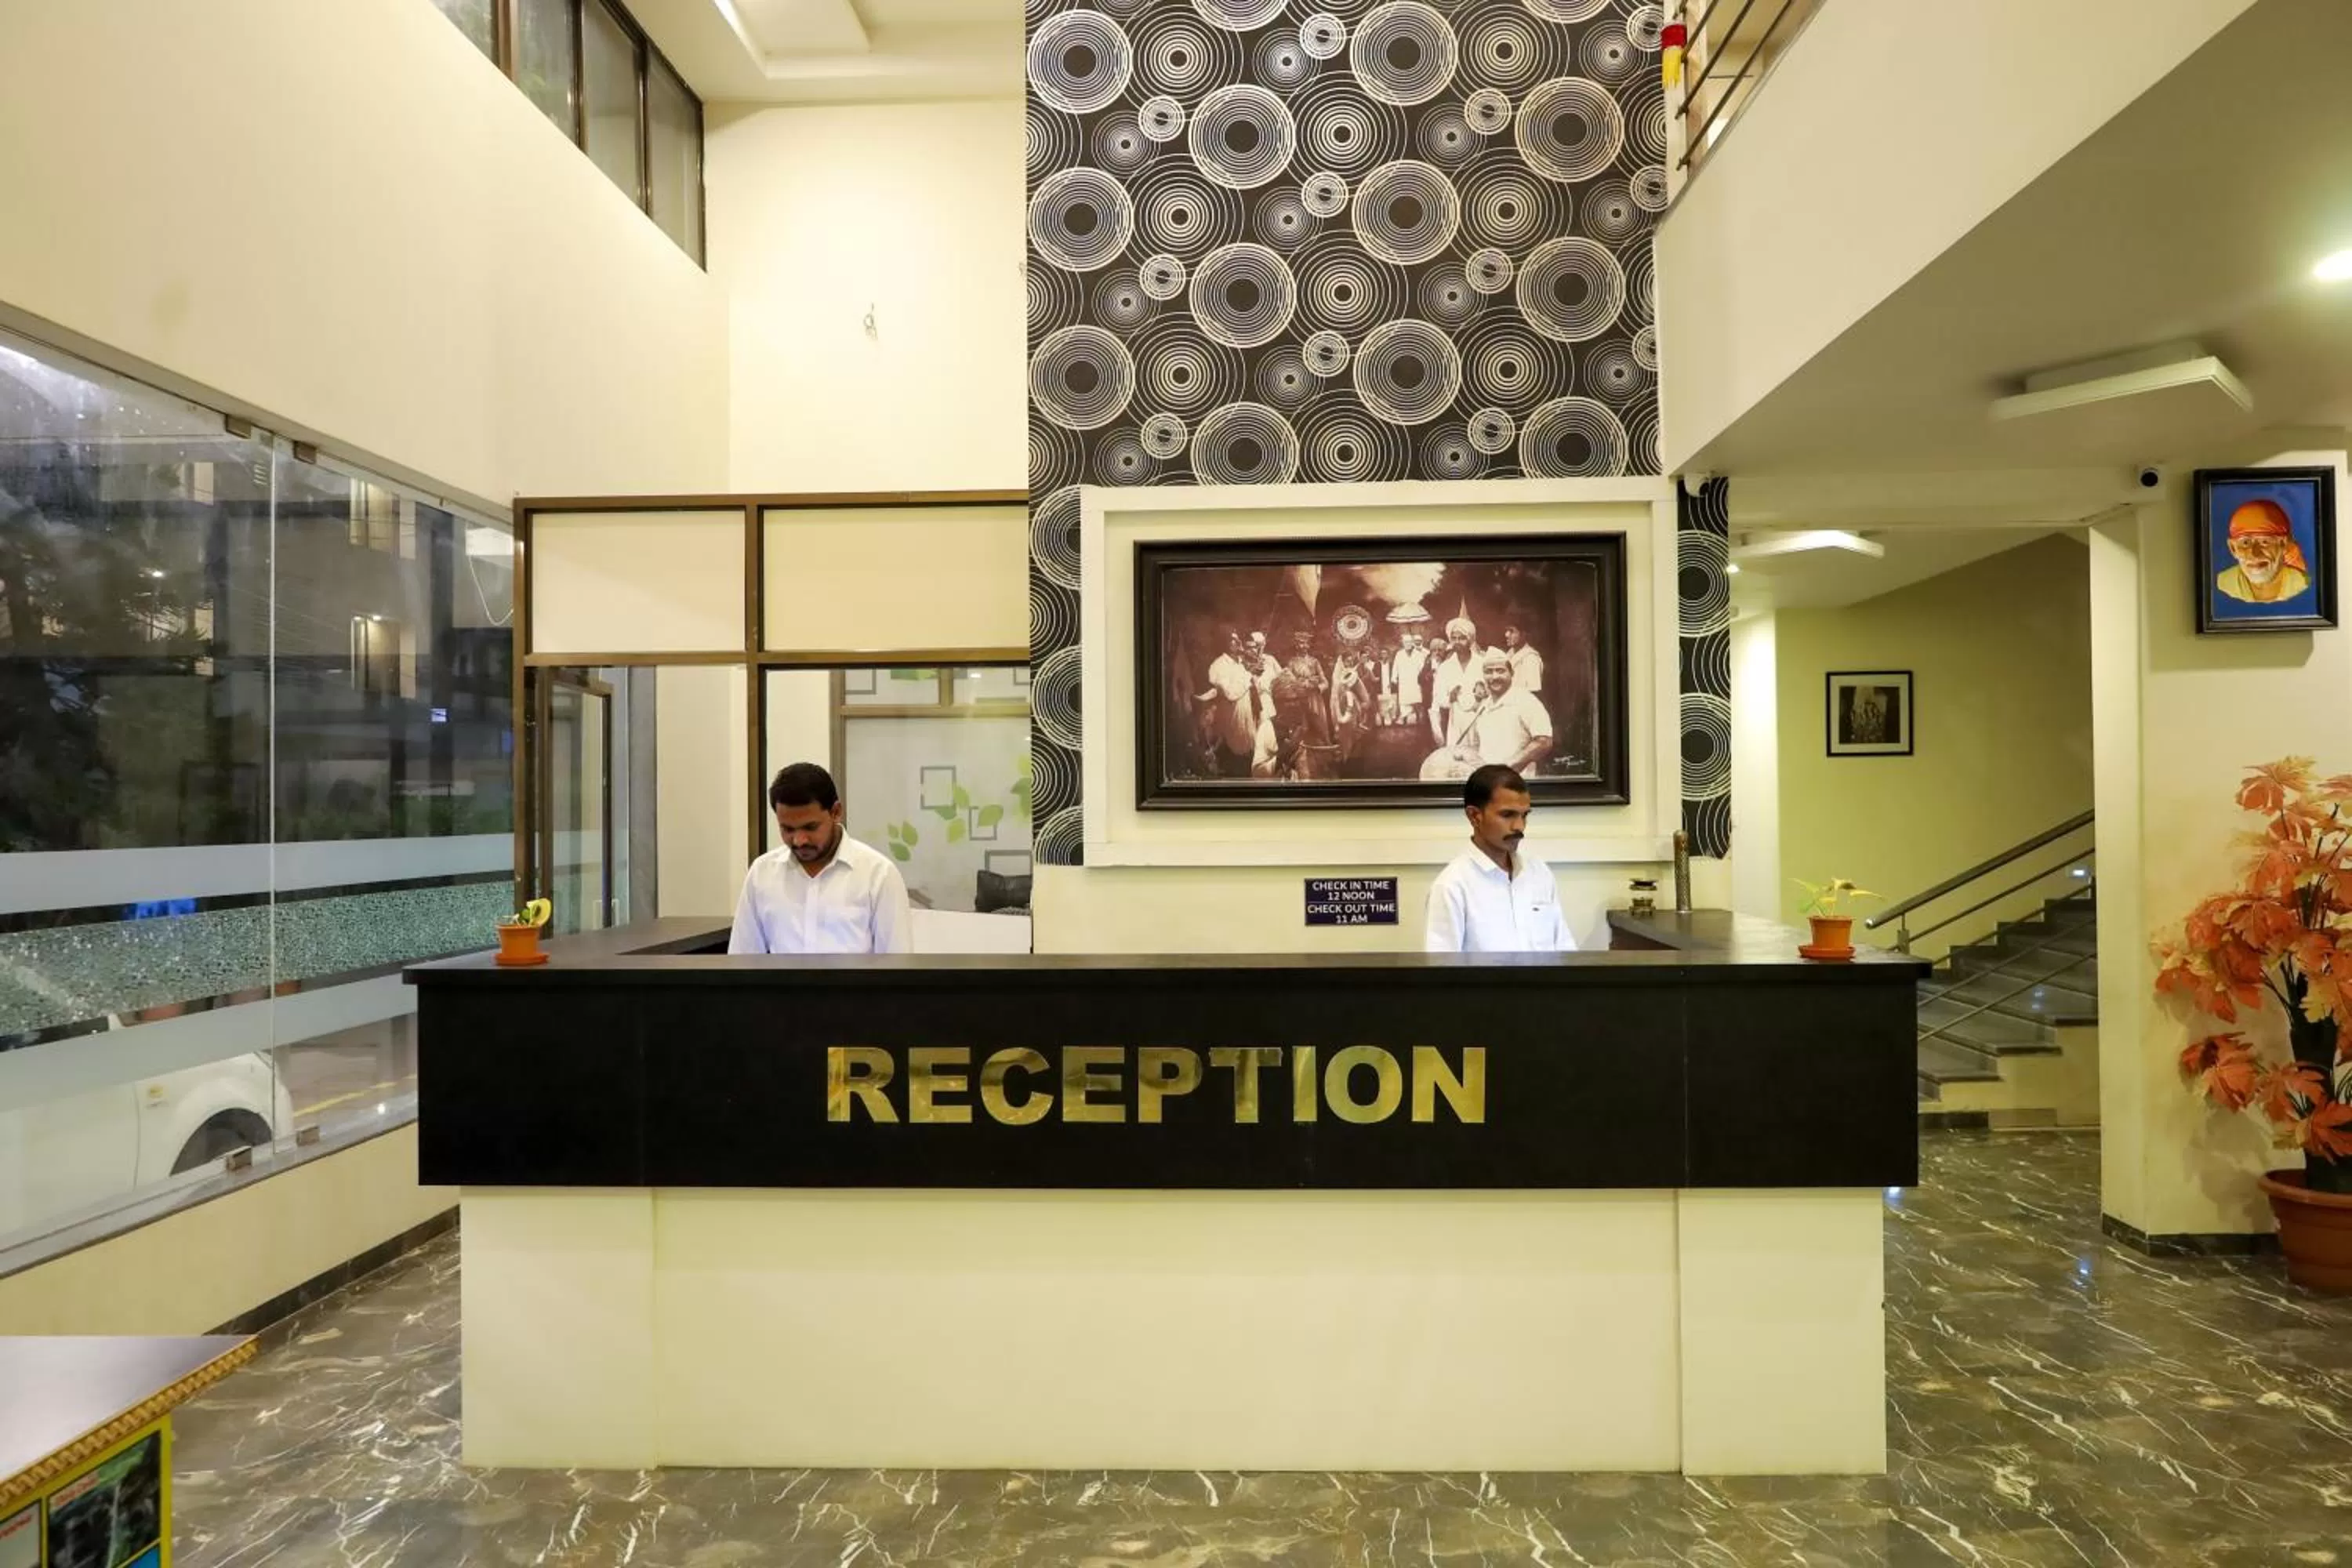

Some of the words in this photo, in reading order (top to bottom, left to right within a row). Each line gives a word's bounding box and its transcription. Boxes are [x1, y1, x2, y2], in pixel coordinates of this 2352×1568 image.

[1312, 880, 1347, 891] CHECK
[1349, 880, 1361, 890] IN
[1363, 880, 1390, 890] TIME
[1327, 891, 1340, 901] 12
[1341, 891, 1375, 900] NOON
[1307, 904, 1343, 913] CHECK
[1345, 904, 1367, 913] OUT
[1370, 902, 1396, 913] TIME
[1335, 915, 1348, 924] 11
[1351, 914, 1368, 923] AM
[826, 1045, 1486, 1124] RECEPTION
